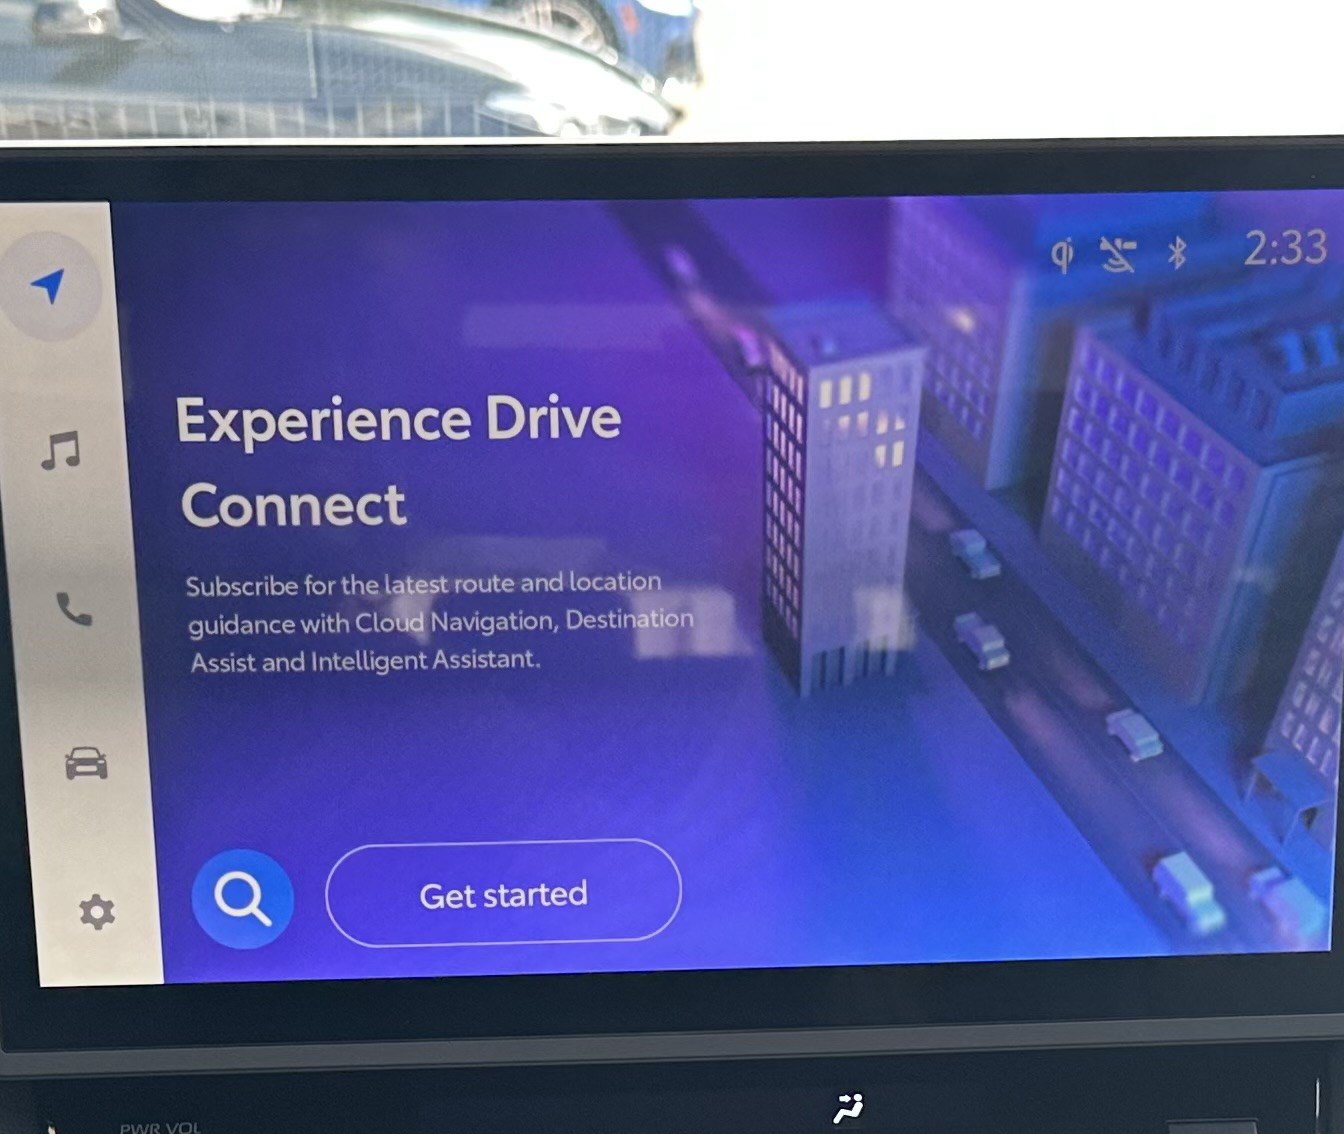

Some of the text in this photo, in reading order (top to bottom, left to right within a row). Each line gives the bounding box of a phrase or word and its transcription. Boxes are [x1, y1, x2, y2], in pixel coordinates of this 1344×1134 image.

[1243, 228, 1328, 266] 2:33
[176, 393, 622, 454] Experience Drive
[181, 482, 408, 528] Connect
[186, 570, 662, 598] Subscribe for the latest route and location
[188, 608, 695, 642] guidance with Cloud Navigation, Destination
[190, 649, 541, 676] Assist and Intelligent Assistant.
[419, 879, 588, 910] Get started
[166, 1122, 201, 1134] VOL
